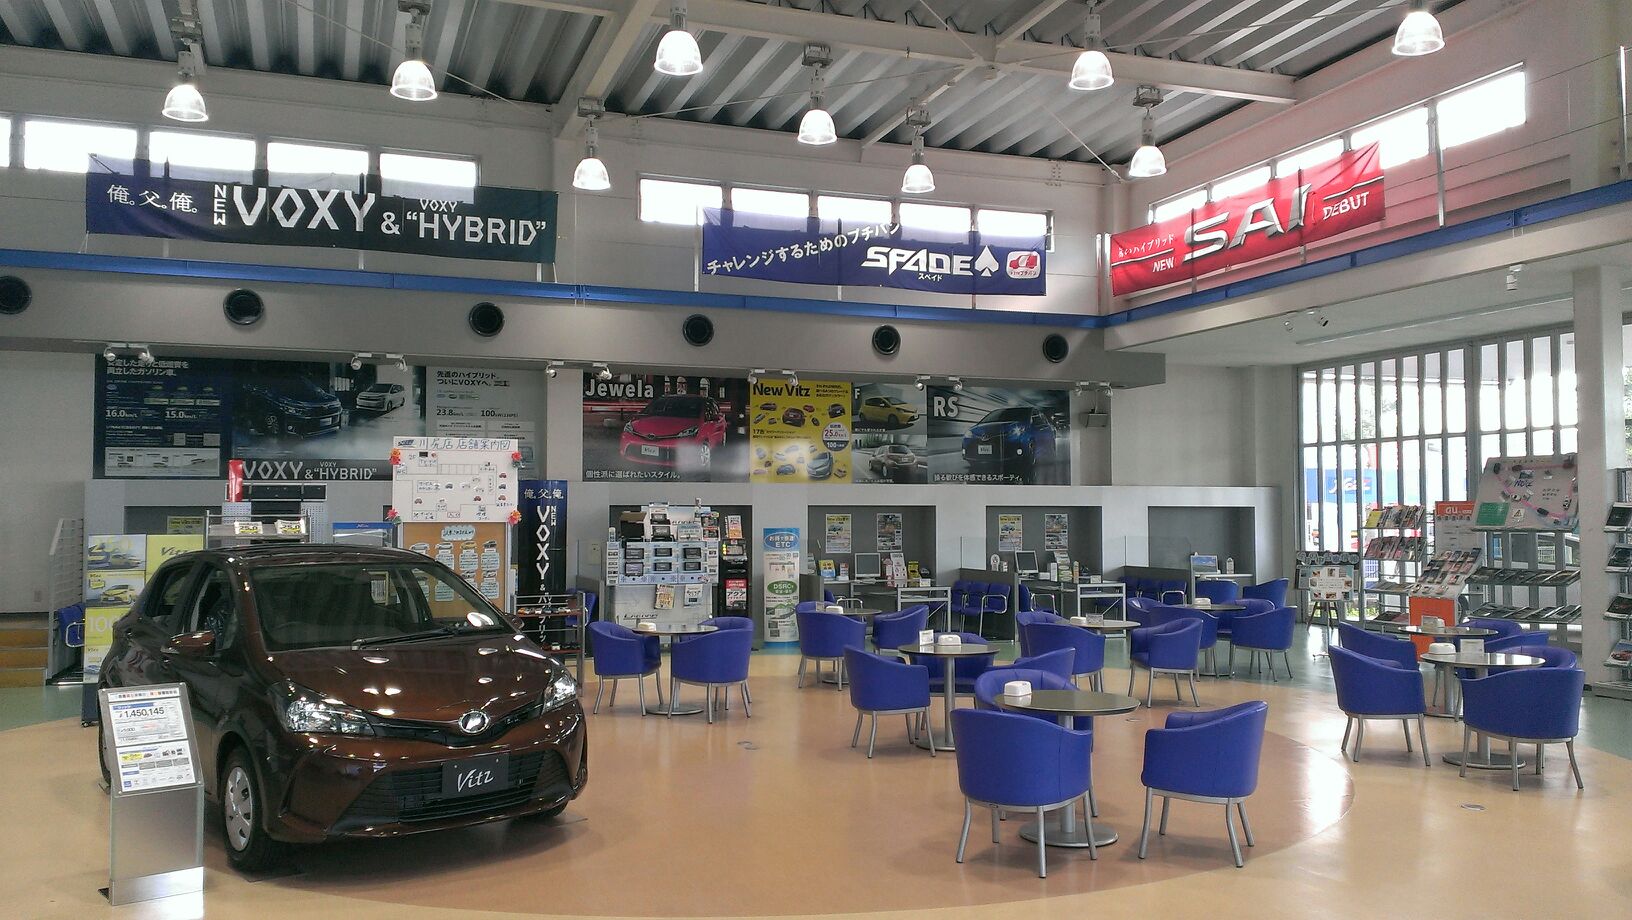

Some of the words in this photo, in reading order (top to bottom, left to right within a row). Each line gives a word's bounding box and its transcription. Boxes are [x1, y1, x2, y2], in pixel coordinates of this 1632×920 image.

[107, 184, 198, 213] 俺。父。俺。
[213, 183, 227, 226] NEW
[232, 185, 376, 232] VOXY
[381, 212, 400, 235] &
[419, 198, 458, 214] VOXY
[1323, 191, 1370, 220] DEBUT
[1183, 183, 1312, 263] SAI
[861, 246, 974, 276] SPADE
[1152, 257, 1175, 272] NEW
[918, 272, 943, 282] スペイド
[585, 379, 654, 398] Jewela
[753, 382, 783, 396] New
[785, 383, 811, 397] Vitz
[933, 396, 959, 418] RS
[243, 461, 303, 479] VOXY
[304, 469, 313, 479] &
[536, 505, 550, 580] VOXY
[457, 769, 494, 792] Vitz
